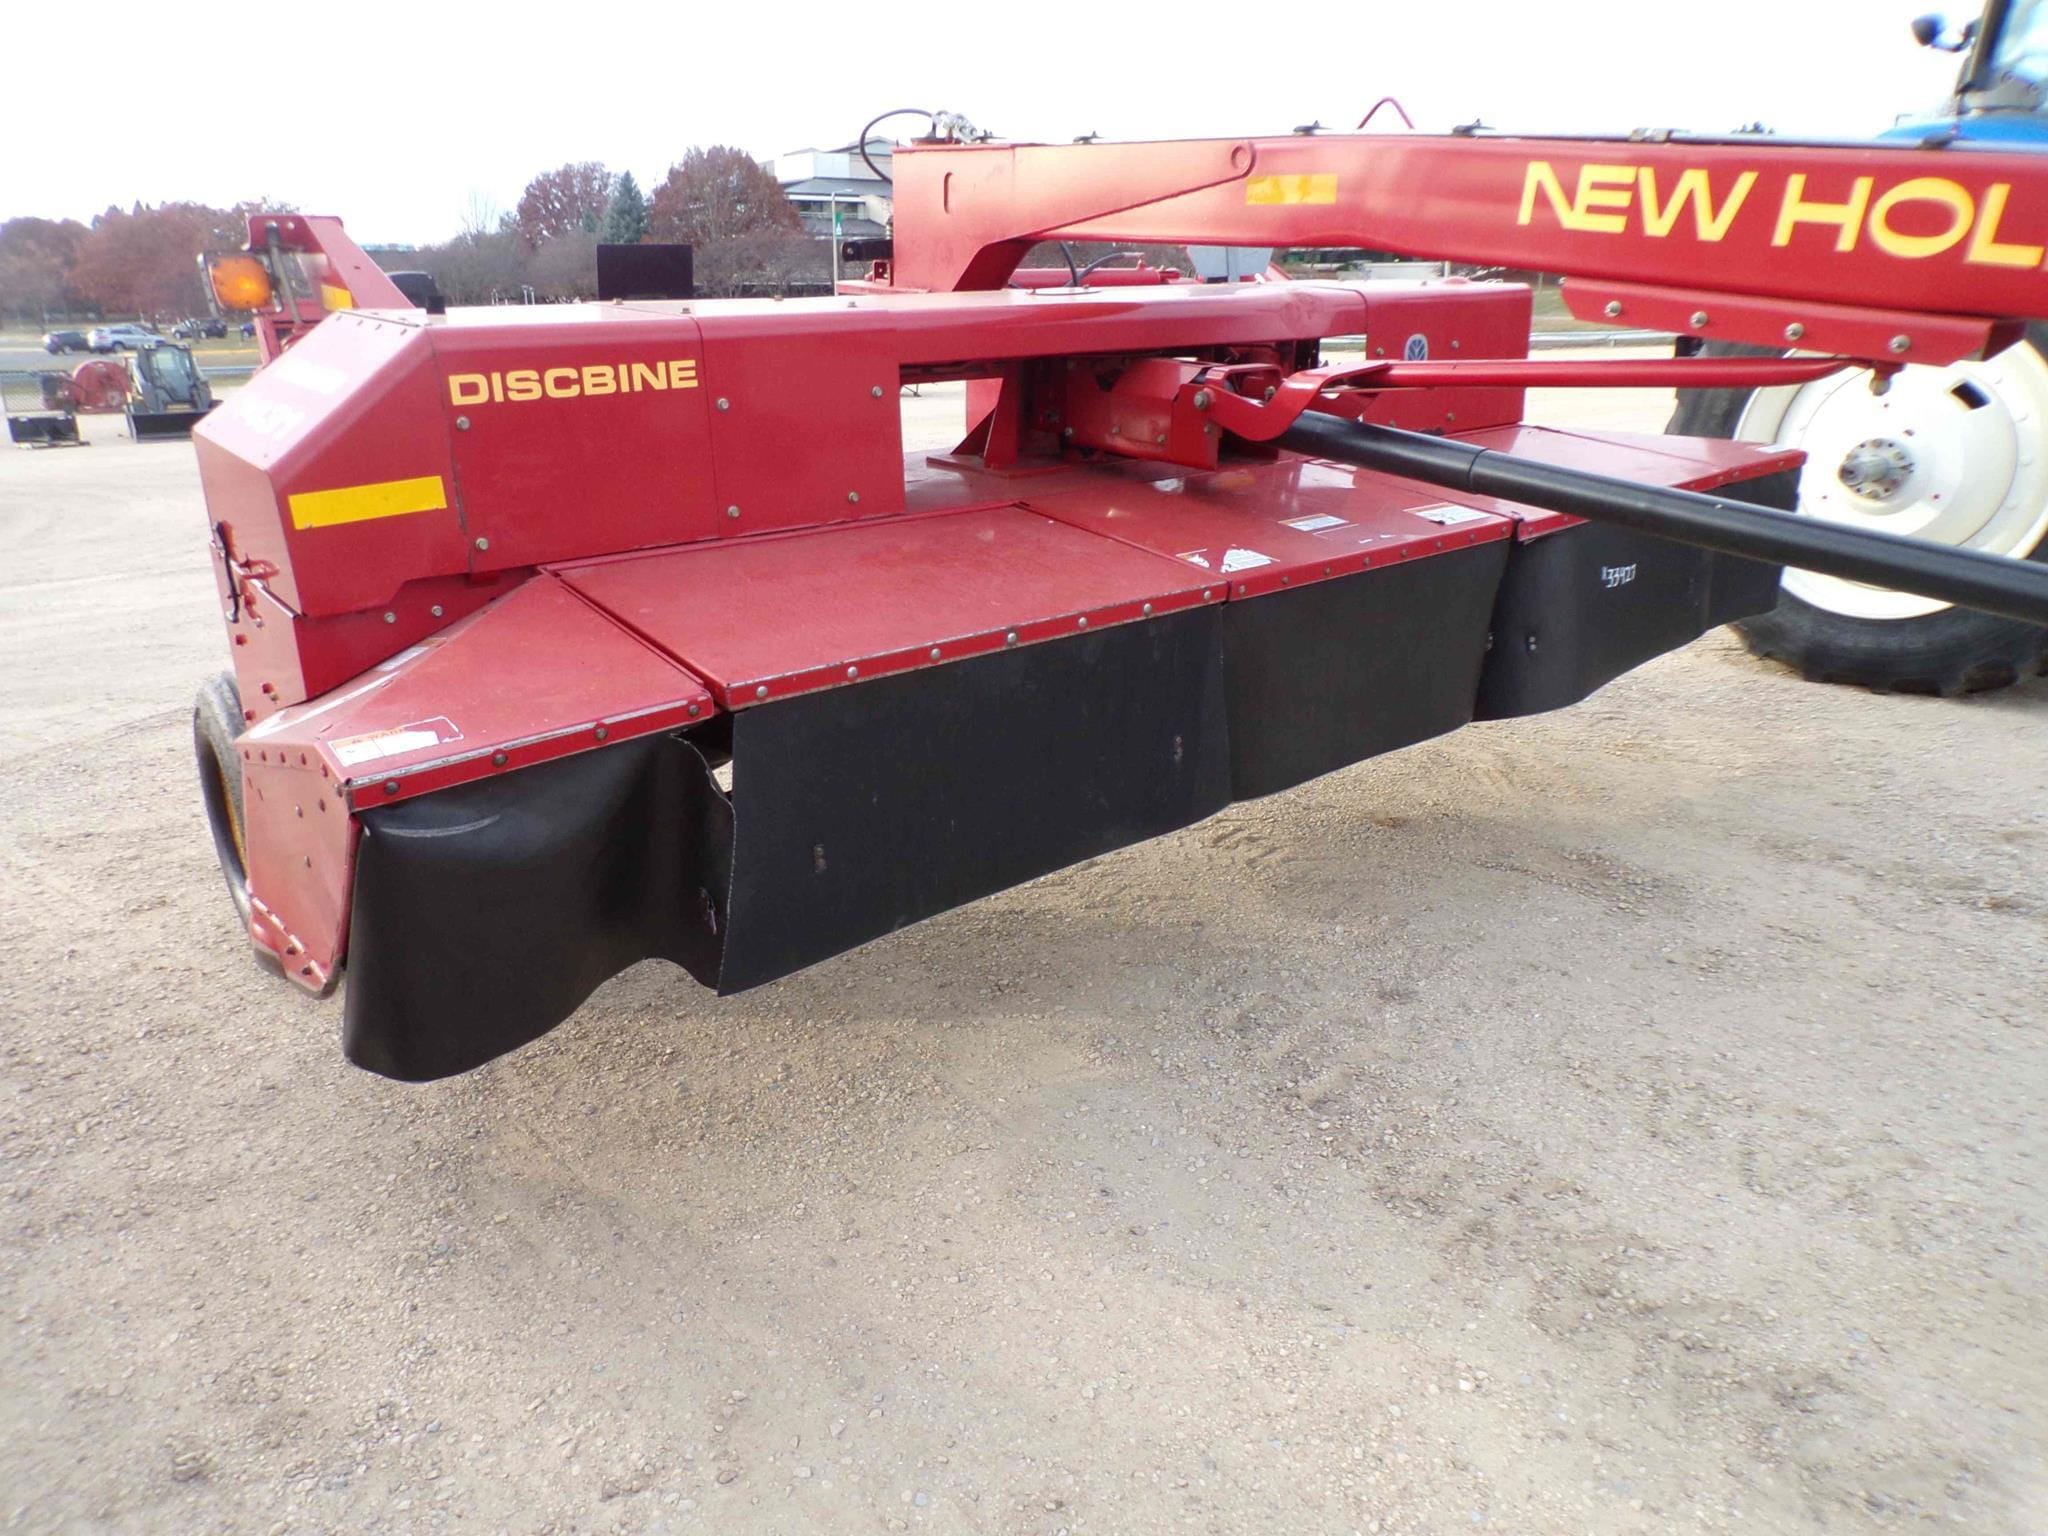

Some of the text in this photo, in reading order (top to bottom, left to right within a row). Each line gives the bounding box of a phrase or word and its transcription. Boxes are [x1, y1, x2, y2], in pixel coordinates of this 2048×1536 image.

[1516, 160, 2048, 269] NEW HOL
[448, 359, 699, 406] DISCBINE
